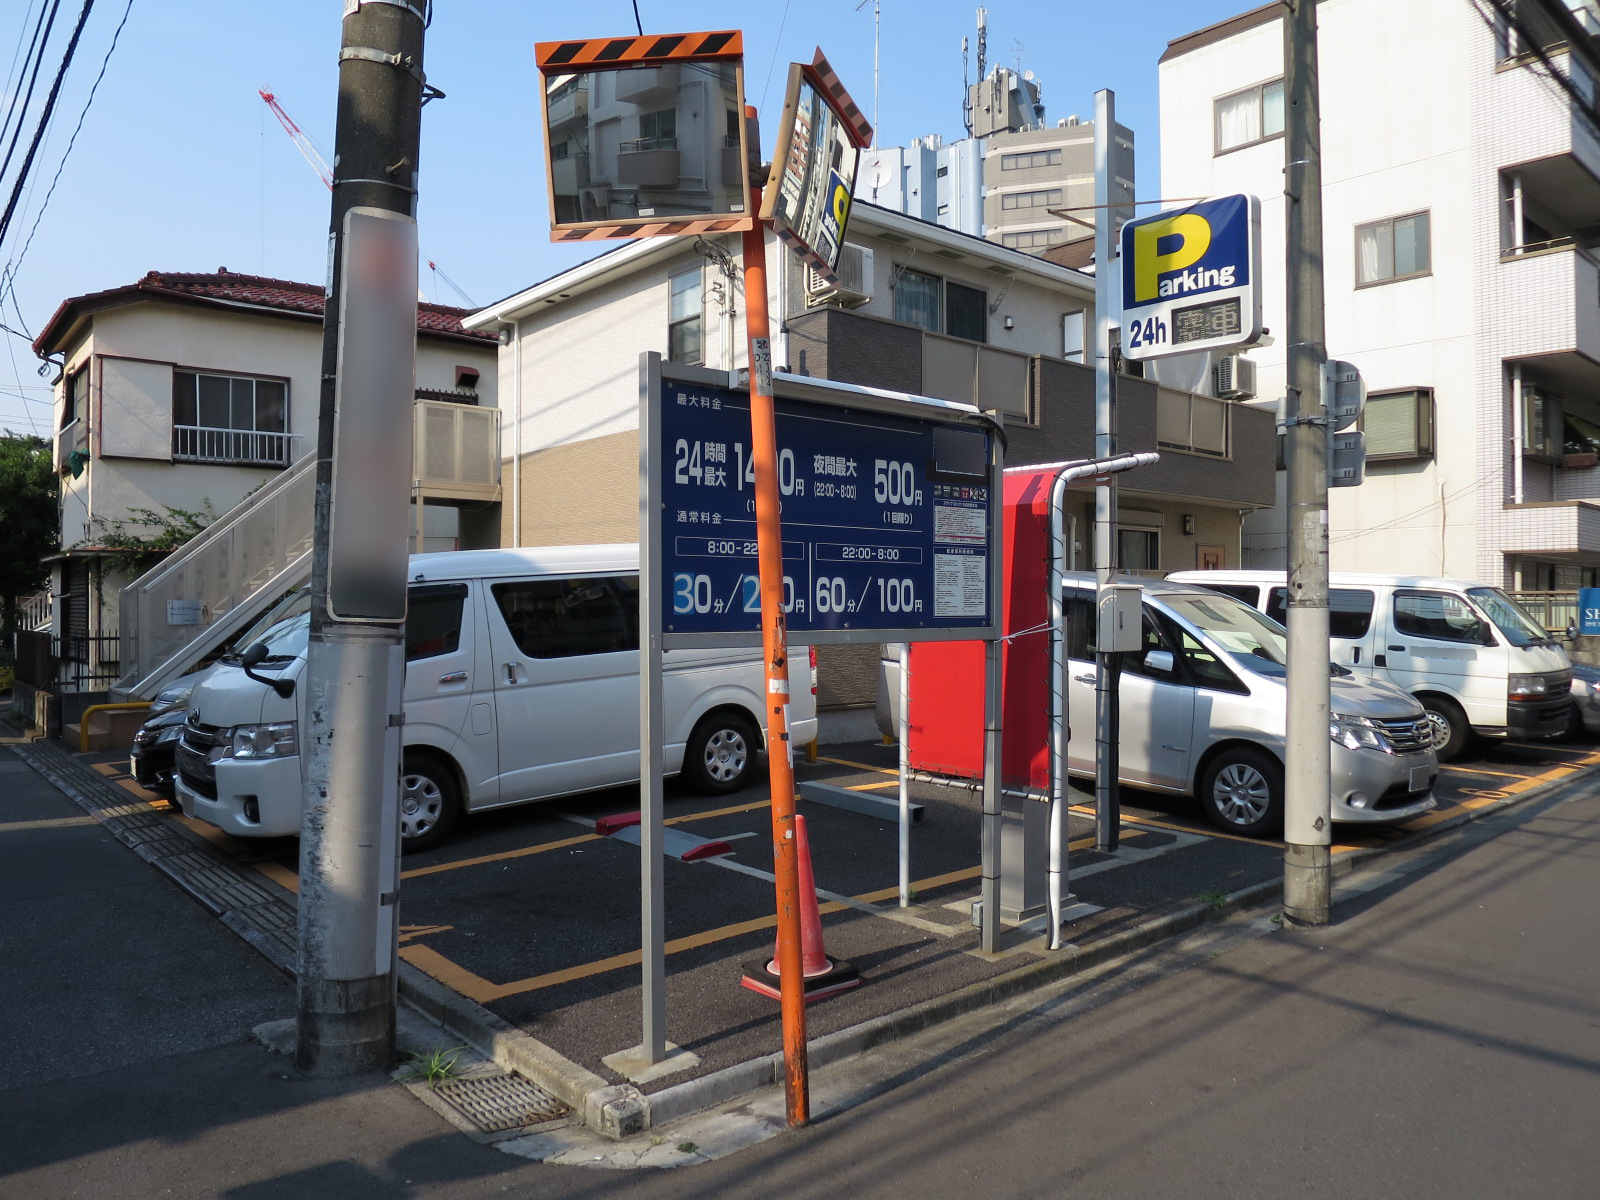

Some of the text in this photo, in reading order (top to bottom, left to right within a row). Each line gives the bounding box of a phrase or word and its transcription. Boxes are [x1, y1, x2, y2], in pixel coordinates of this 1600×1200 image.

[1134, 212, 1236, 303] Parking
[1129, 316, 1167, 349] 24h
[676, 392, 722, 410] 最大料金
[675, 438, 703, 486] 24
[813, 454, 858, 478] 夜間最大
[704, 466, 727, 487] 最大
[874, 459, 923, 506] 500円
[677, 510, 722, 525] 通常料金
[842, 546, 900, 560] 22:00-8:00
